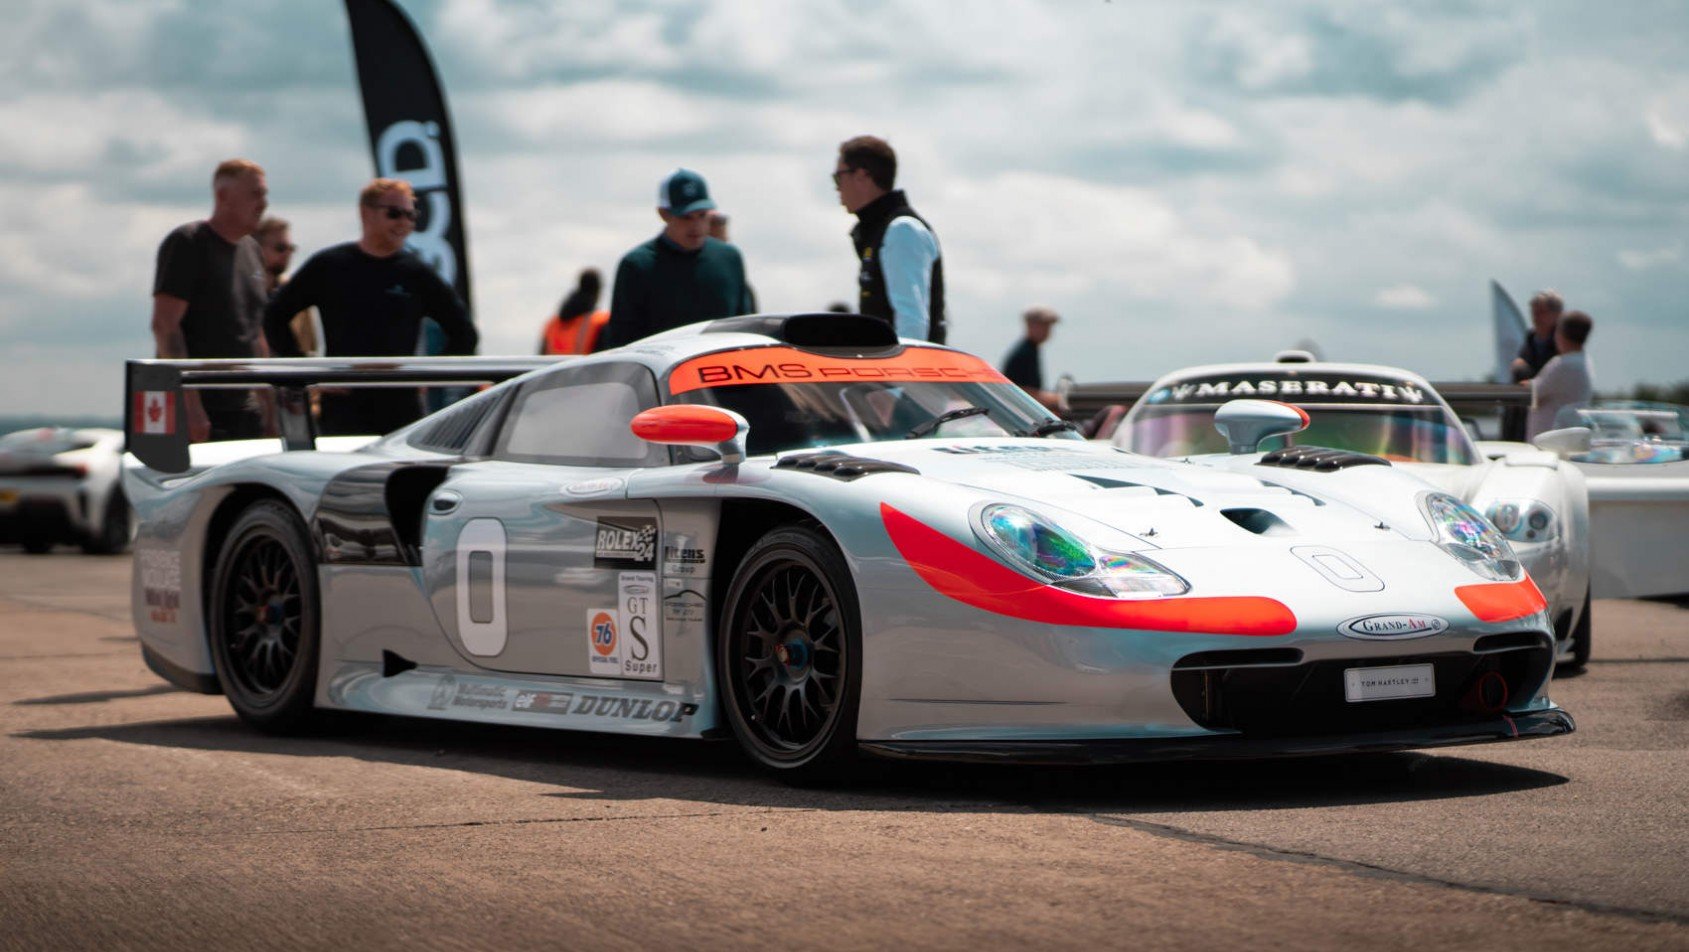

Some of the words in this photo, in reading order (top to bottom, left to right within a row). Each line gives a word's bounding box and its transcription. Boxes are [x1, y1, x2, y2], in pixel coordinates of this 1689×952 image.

[698, 363, 812, 383] BMS
[1196, 381, 1398, 399] MASERATI
[597, 530, 640, 550] ROLEX
[634, 540, 655, 562] 24
[456, 516, 509, 658] 0
[627, 596, 649, 615] GT
[595, 622, 613, 645] 76
[629, 615, 649, 661] S
[625, 660, 657, 674] Super
[1377, 678, 1410, 686] HARTLEY
[573, 694, 699, 723] DUNLOP
